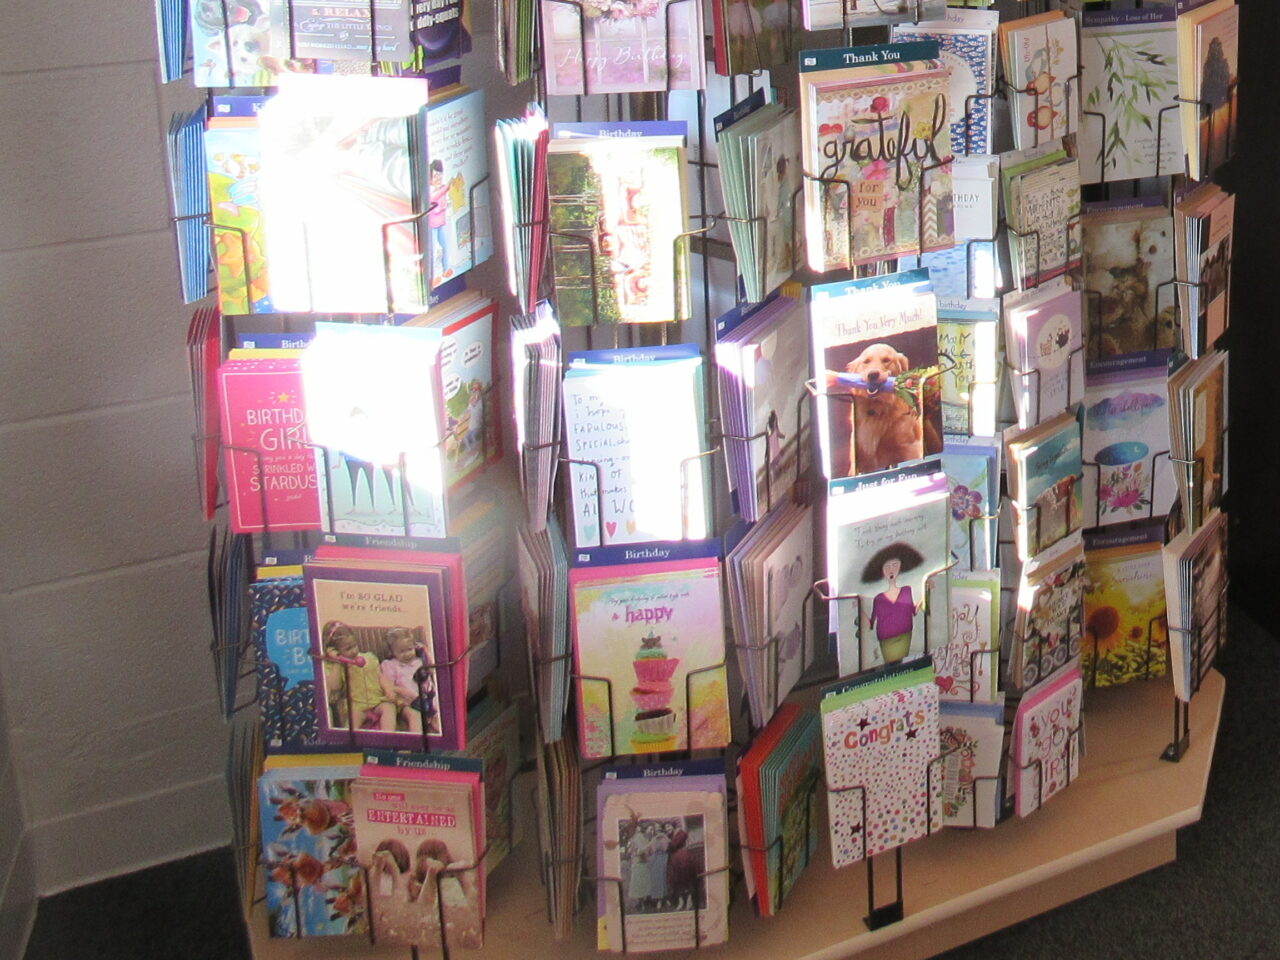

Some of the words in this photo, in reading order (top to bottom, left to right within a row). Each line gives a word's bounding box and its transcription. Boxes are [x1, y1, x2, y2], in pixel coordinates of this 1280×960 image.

[1086, 15, 1120, 24] Sympathy
[844, 52, 878, 64] Thank
[881, 51, 900, 61] You
[821, 93, 946, 190] grateful
[858, 182, 879, 193] for
[856, 196, 876, 209] you
[940, 301, 967, 310] birthday
[835, 320, 862, 336] Thank
[863, 318, 878, 331] You
[880, 316, 896, 331] Very
[898, 308, 922, 326] Much!
[880, 478, 895, 486] for
[366, 536, 417, 549] Friendship
[625, 548, 670, 560] Birthday
[358, 592, 371, 601] SO
[373, 593, 403, 603] GLAD
[626, 605, 673, 624] happy
[842, 668, 914, 693] Congratulations
[843, 707, 926, 751] Congrats
[396, 757, 451, 770] Friendship
[643, 767, 683, 777] Birthday
[368, 810, 456, 827] ENTERTAINED
